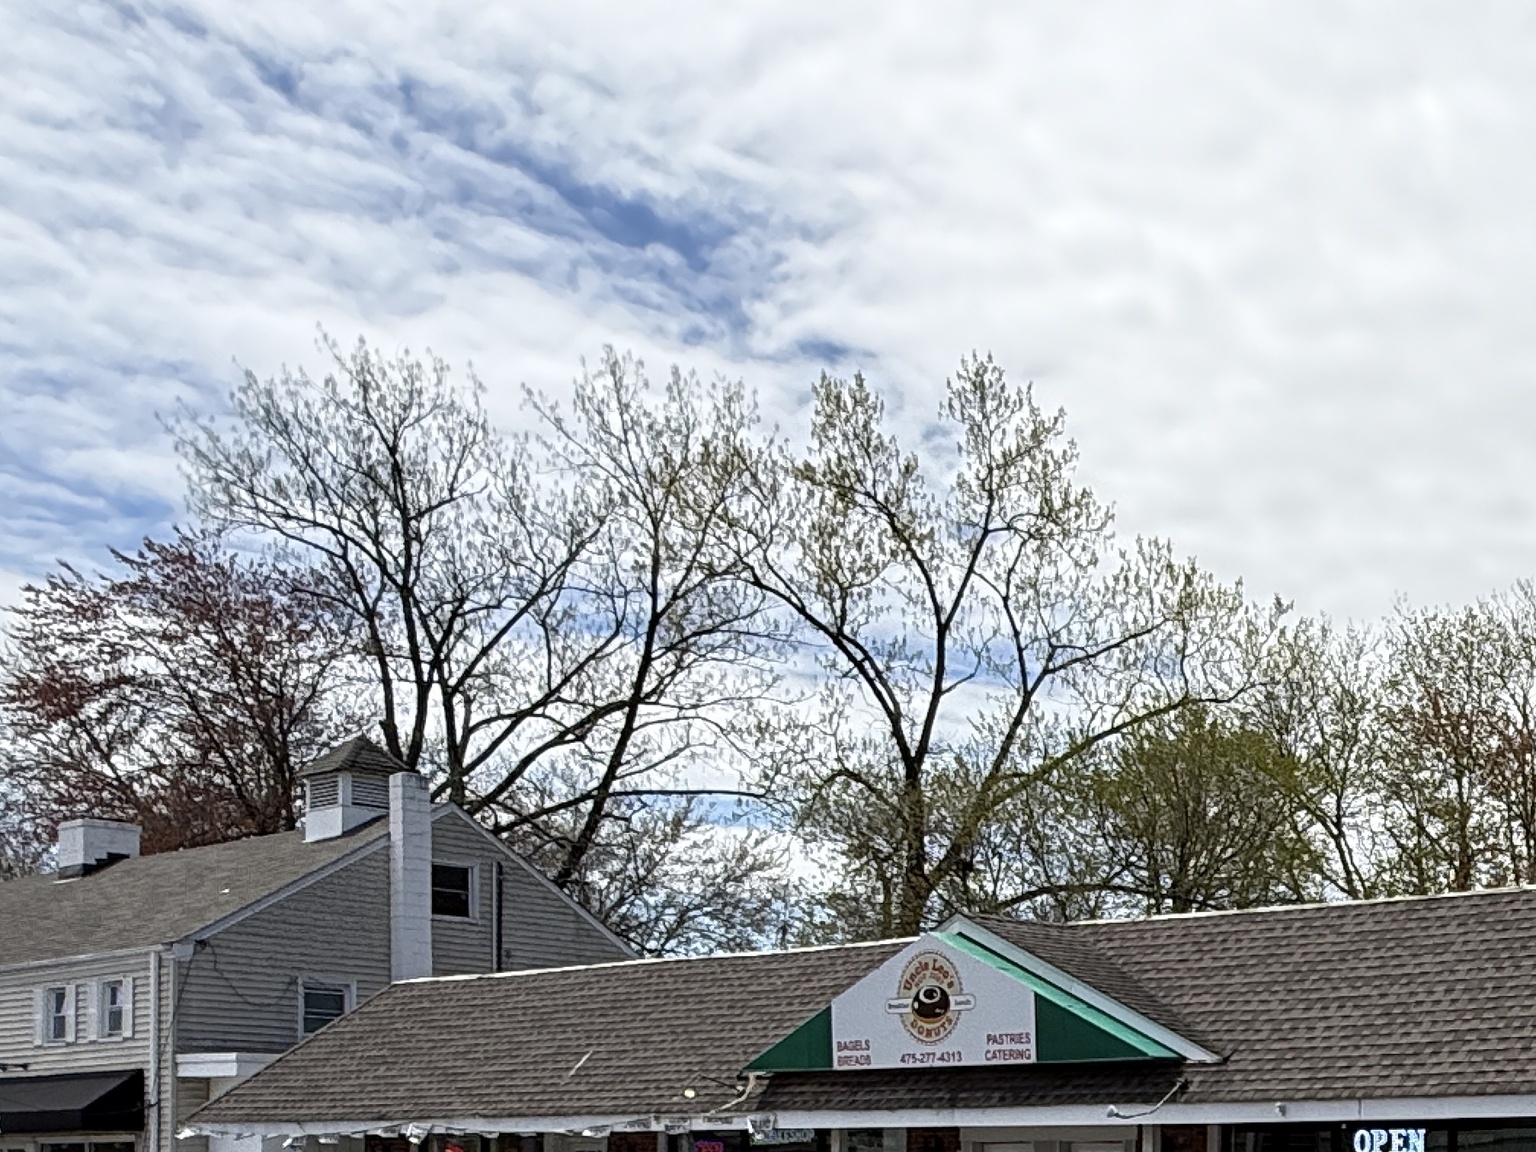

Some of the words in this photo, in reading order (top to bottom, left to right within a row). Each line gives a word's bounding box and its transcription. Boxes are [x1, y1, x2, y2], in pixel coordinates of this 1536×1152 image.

[903, 961, 929, 990] Uncle
[911, 1016, 953, 1038] DONUTS
[837, 1040, 870, 1051] BAGELS
[986, 1033, 1031, 1045] PASTRIES
[837, 1055, 871, 1066] BREADS
[900, 1051, 962, 1064] 475-277-4313
[985, 1049, 1031, 1062] CATERING
